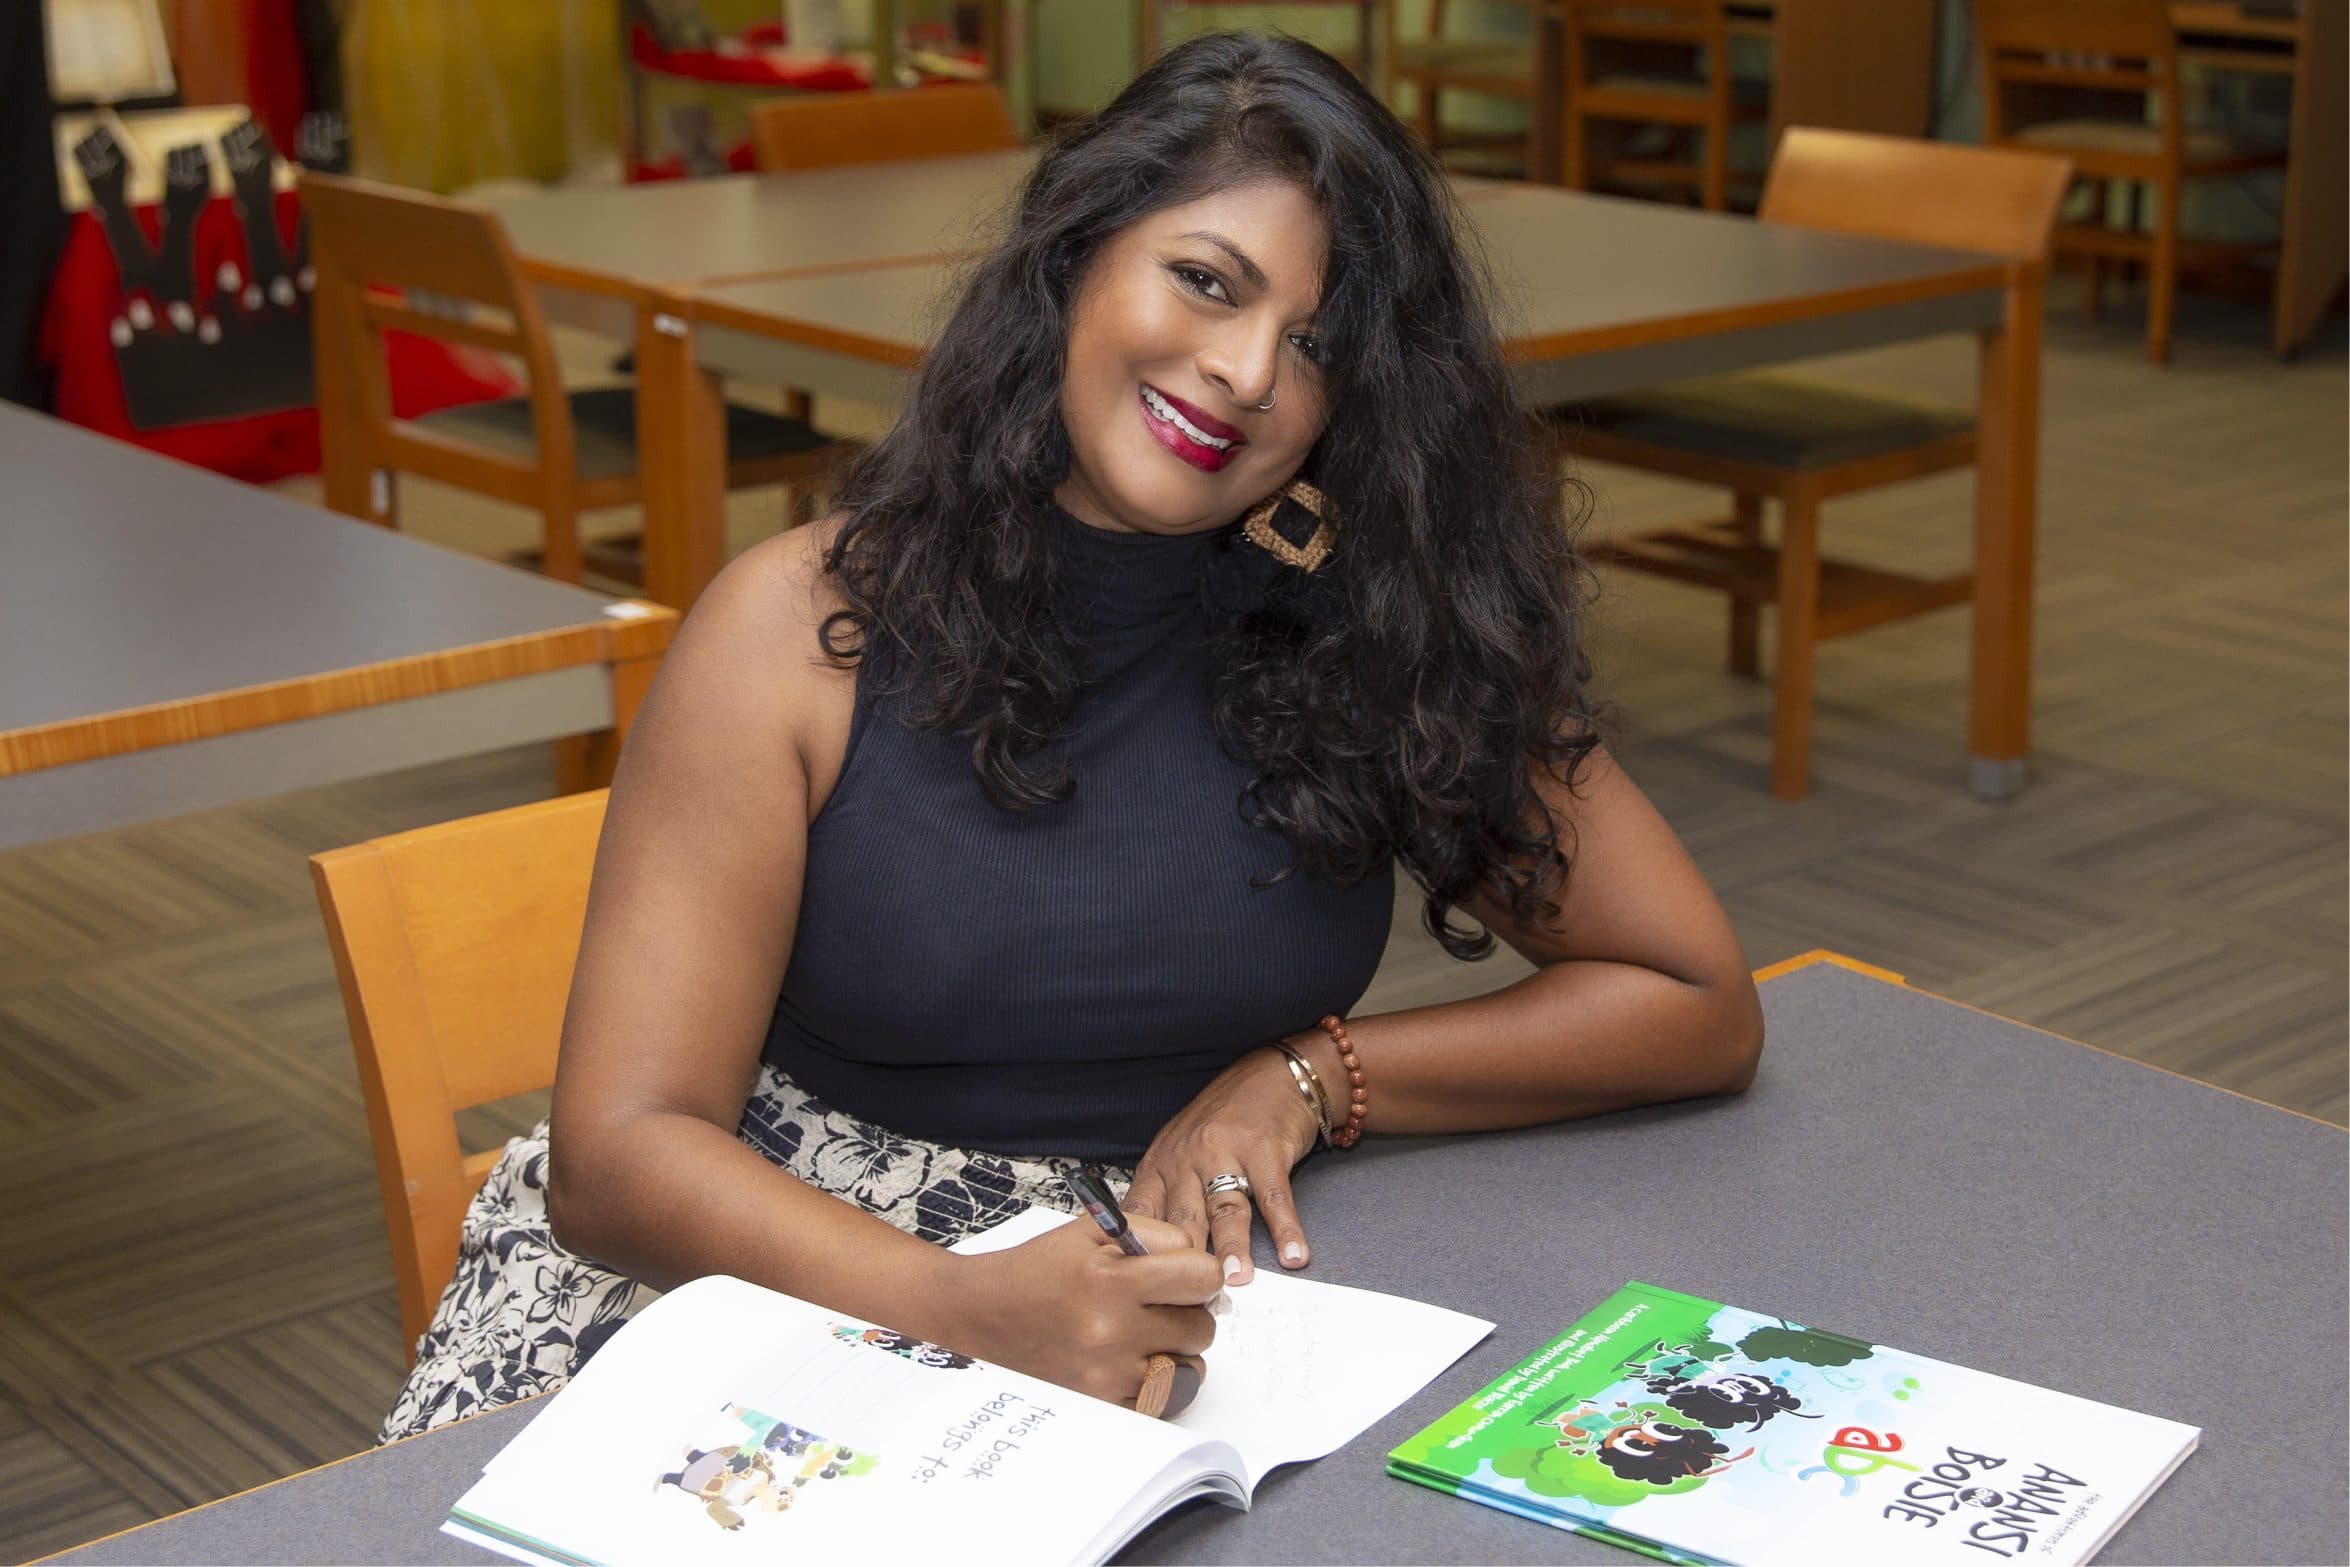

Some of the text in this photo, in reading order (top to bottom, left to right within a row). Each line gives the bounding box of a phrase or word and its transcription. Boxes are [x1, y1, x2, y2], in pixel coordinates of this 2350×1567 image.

[943, 1393, 1024, 1450] belongs
[965, 1405, 1056, 1479] this book
[1798, 1426, 1921, 1495] abc
[1883, 1445, 2007, 1529] BOISIE
[1960, 1462, 2088, 1558] ANANSI
